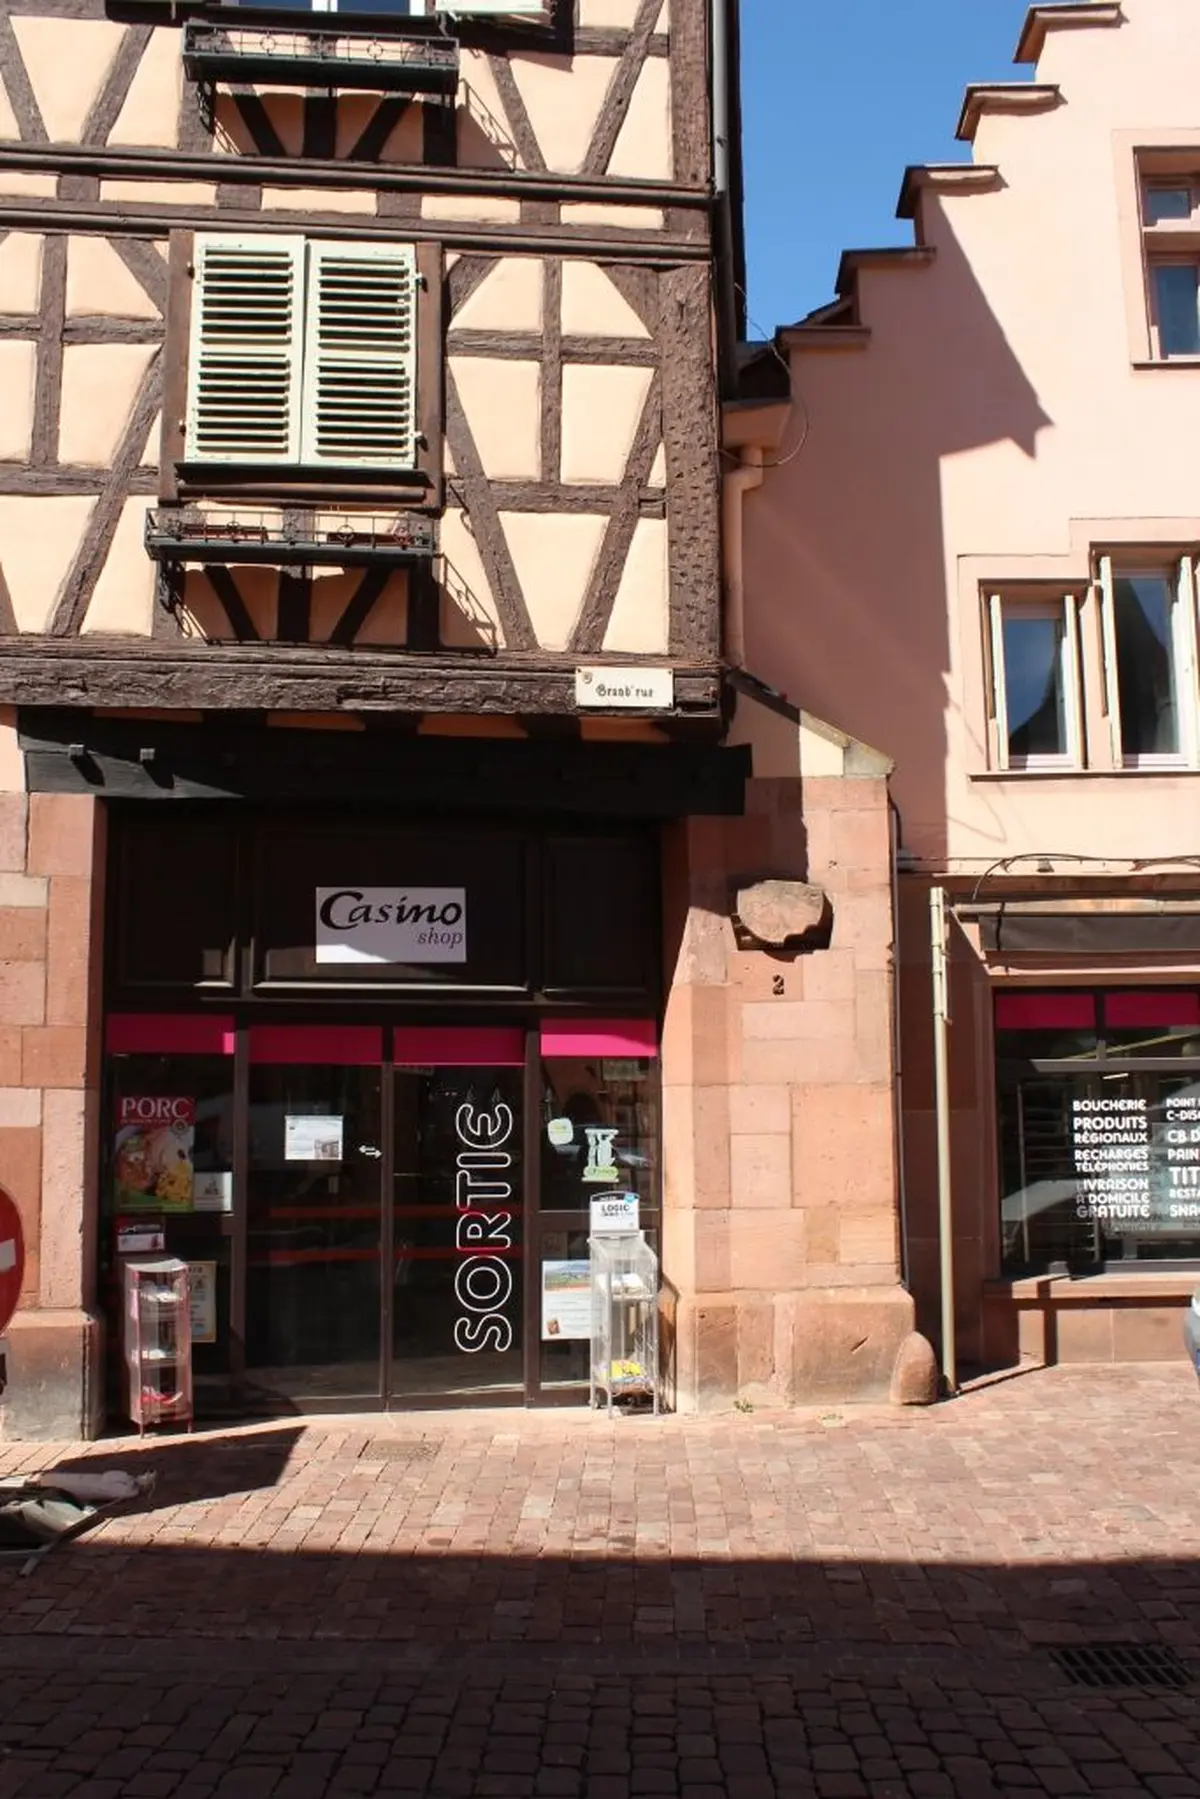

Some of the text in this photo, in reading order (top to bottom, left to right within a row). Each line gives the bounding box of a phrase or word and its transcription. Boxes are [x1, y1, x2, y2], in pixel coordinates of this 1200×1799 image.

[320, 891, 463, 930] Casino
[417, 928, 464, 949] shop
[121, 1097, 191, 1118] PORC
[1073, 1099, 1146, 1111] BOUCHERIE
[1166, 1098, 1196, 1107] POINT
[1074, 1116, 1147, 1130] PRODUITS
[1167, 1130, 1187, 1143] CB
[1074, 1148, 1148, 1161] RECHARGES
[1168, 1148, 1199, 1160] PAIN
[1076, 1179, 1149, 1191] LIVRAISON
[1088, 1192, 1150, 1204] DOMICILE
[1077, 1205, 1150, 1218] GRATUITE
[1170, 1204, 1200, 1217] SNA
[454, 1103, 513, 1352] SORTIE
